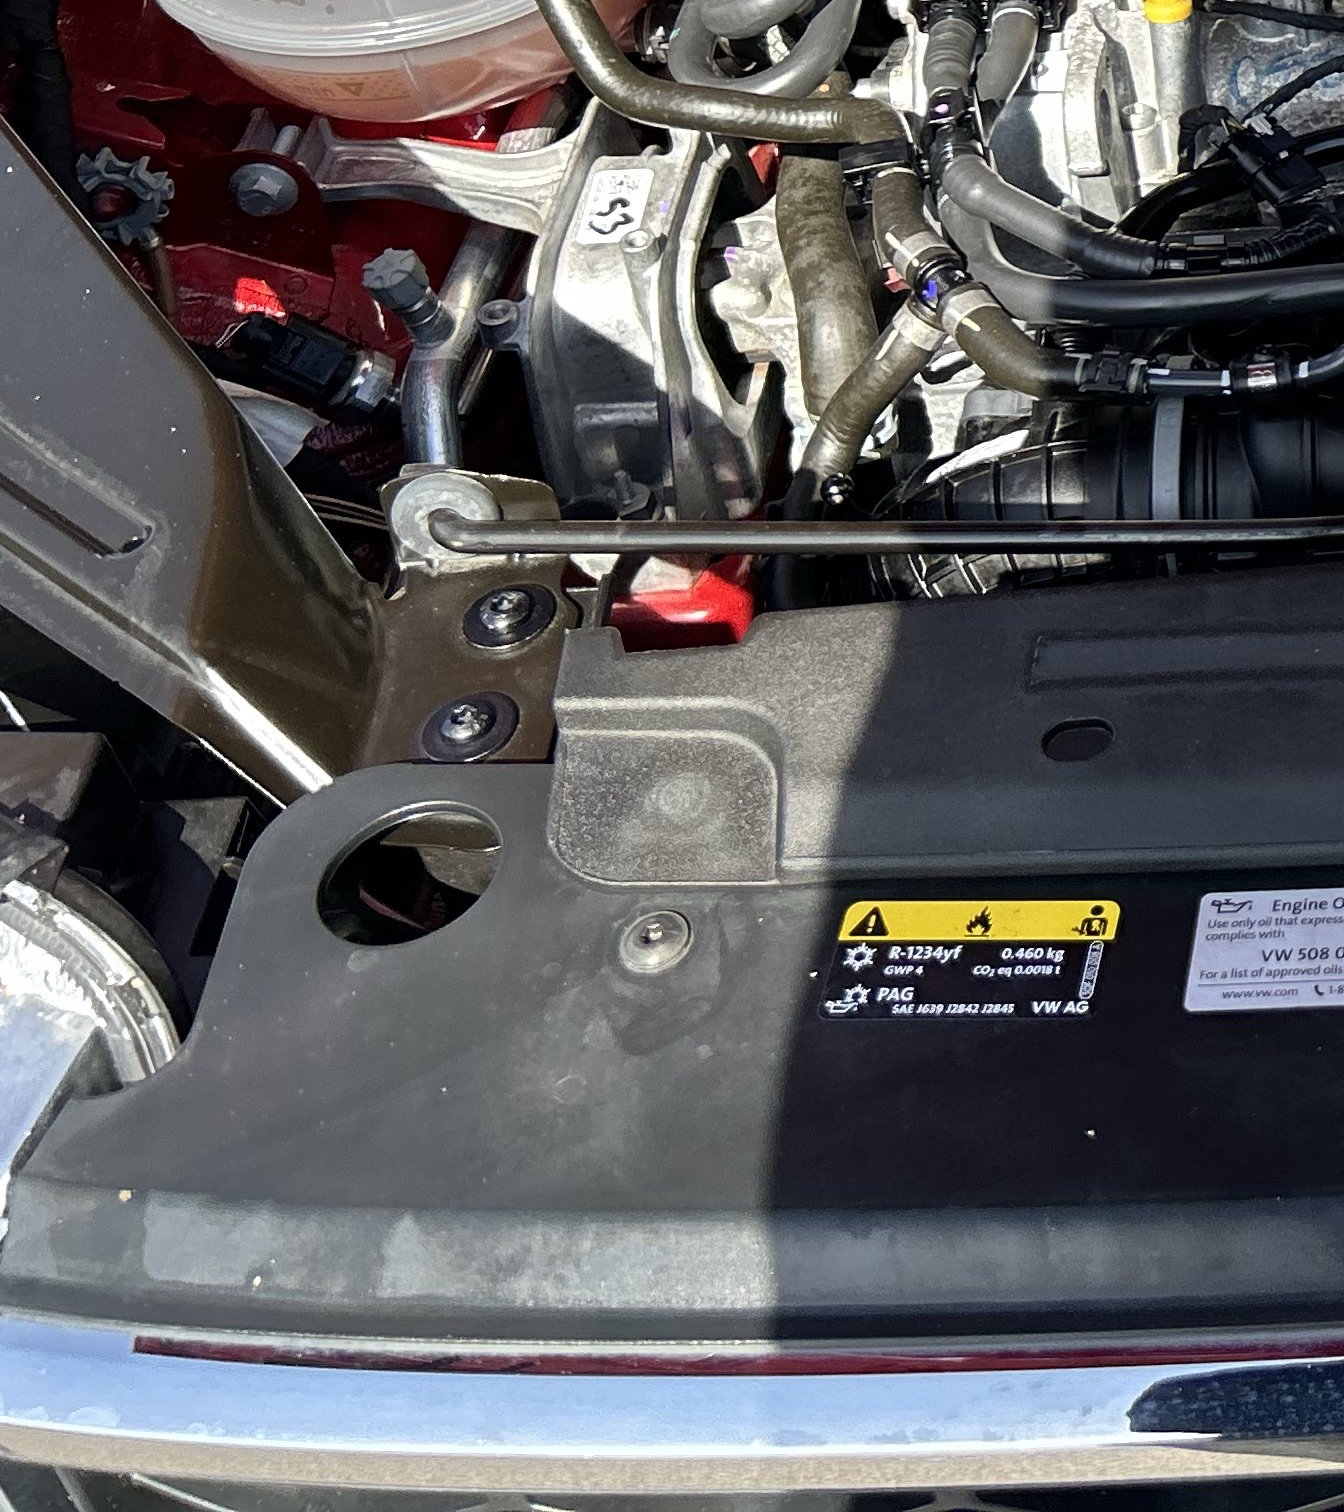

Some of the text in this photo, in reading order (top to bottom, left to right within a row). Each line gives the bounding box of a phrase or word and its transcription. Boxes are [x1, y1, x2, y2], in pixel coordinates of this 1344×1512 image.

[1272, 897, 1328, 915] Engine
[1207, 918, 1229, 929] Use
[1230, 917, 1256, 930] only
[1257, 917, 1272, 927] oil
[1274, 916, 1298, 926] that
[1204, 930, 1256, 943] complies
[887, 945, 963, 963] R-1234yf
[1000, 947, 1065, 962] 0.460 kg
[1260, 948, 1294, 962] VW
[1297, 946, 1329, 961] 508
[884, 965, 924, 975] GWP 4
[997, 967, 1012, 976] eq
[1014, 965, 1052, 975] 0.0018
[1054, 965, 1060, 975] t
[1199, 969, 1219, 979] For
[1229, 968, 1248, 978] list
[1250, 967, 1264, 977] of
[1265, 965, 1321, 979] approved
[876, 987, 914, 1000] PAG
[1221, 987, 1298, 999] www.vw.com
[892, 1004, 1014, 1013] SAE J639 J2842 J2845
[1031, 1001, 1089, 1013] VW AG
